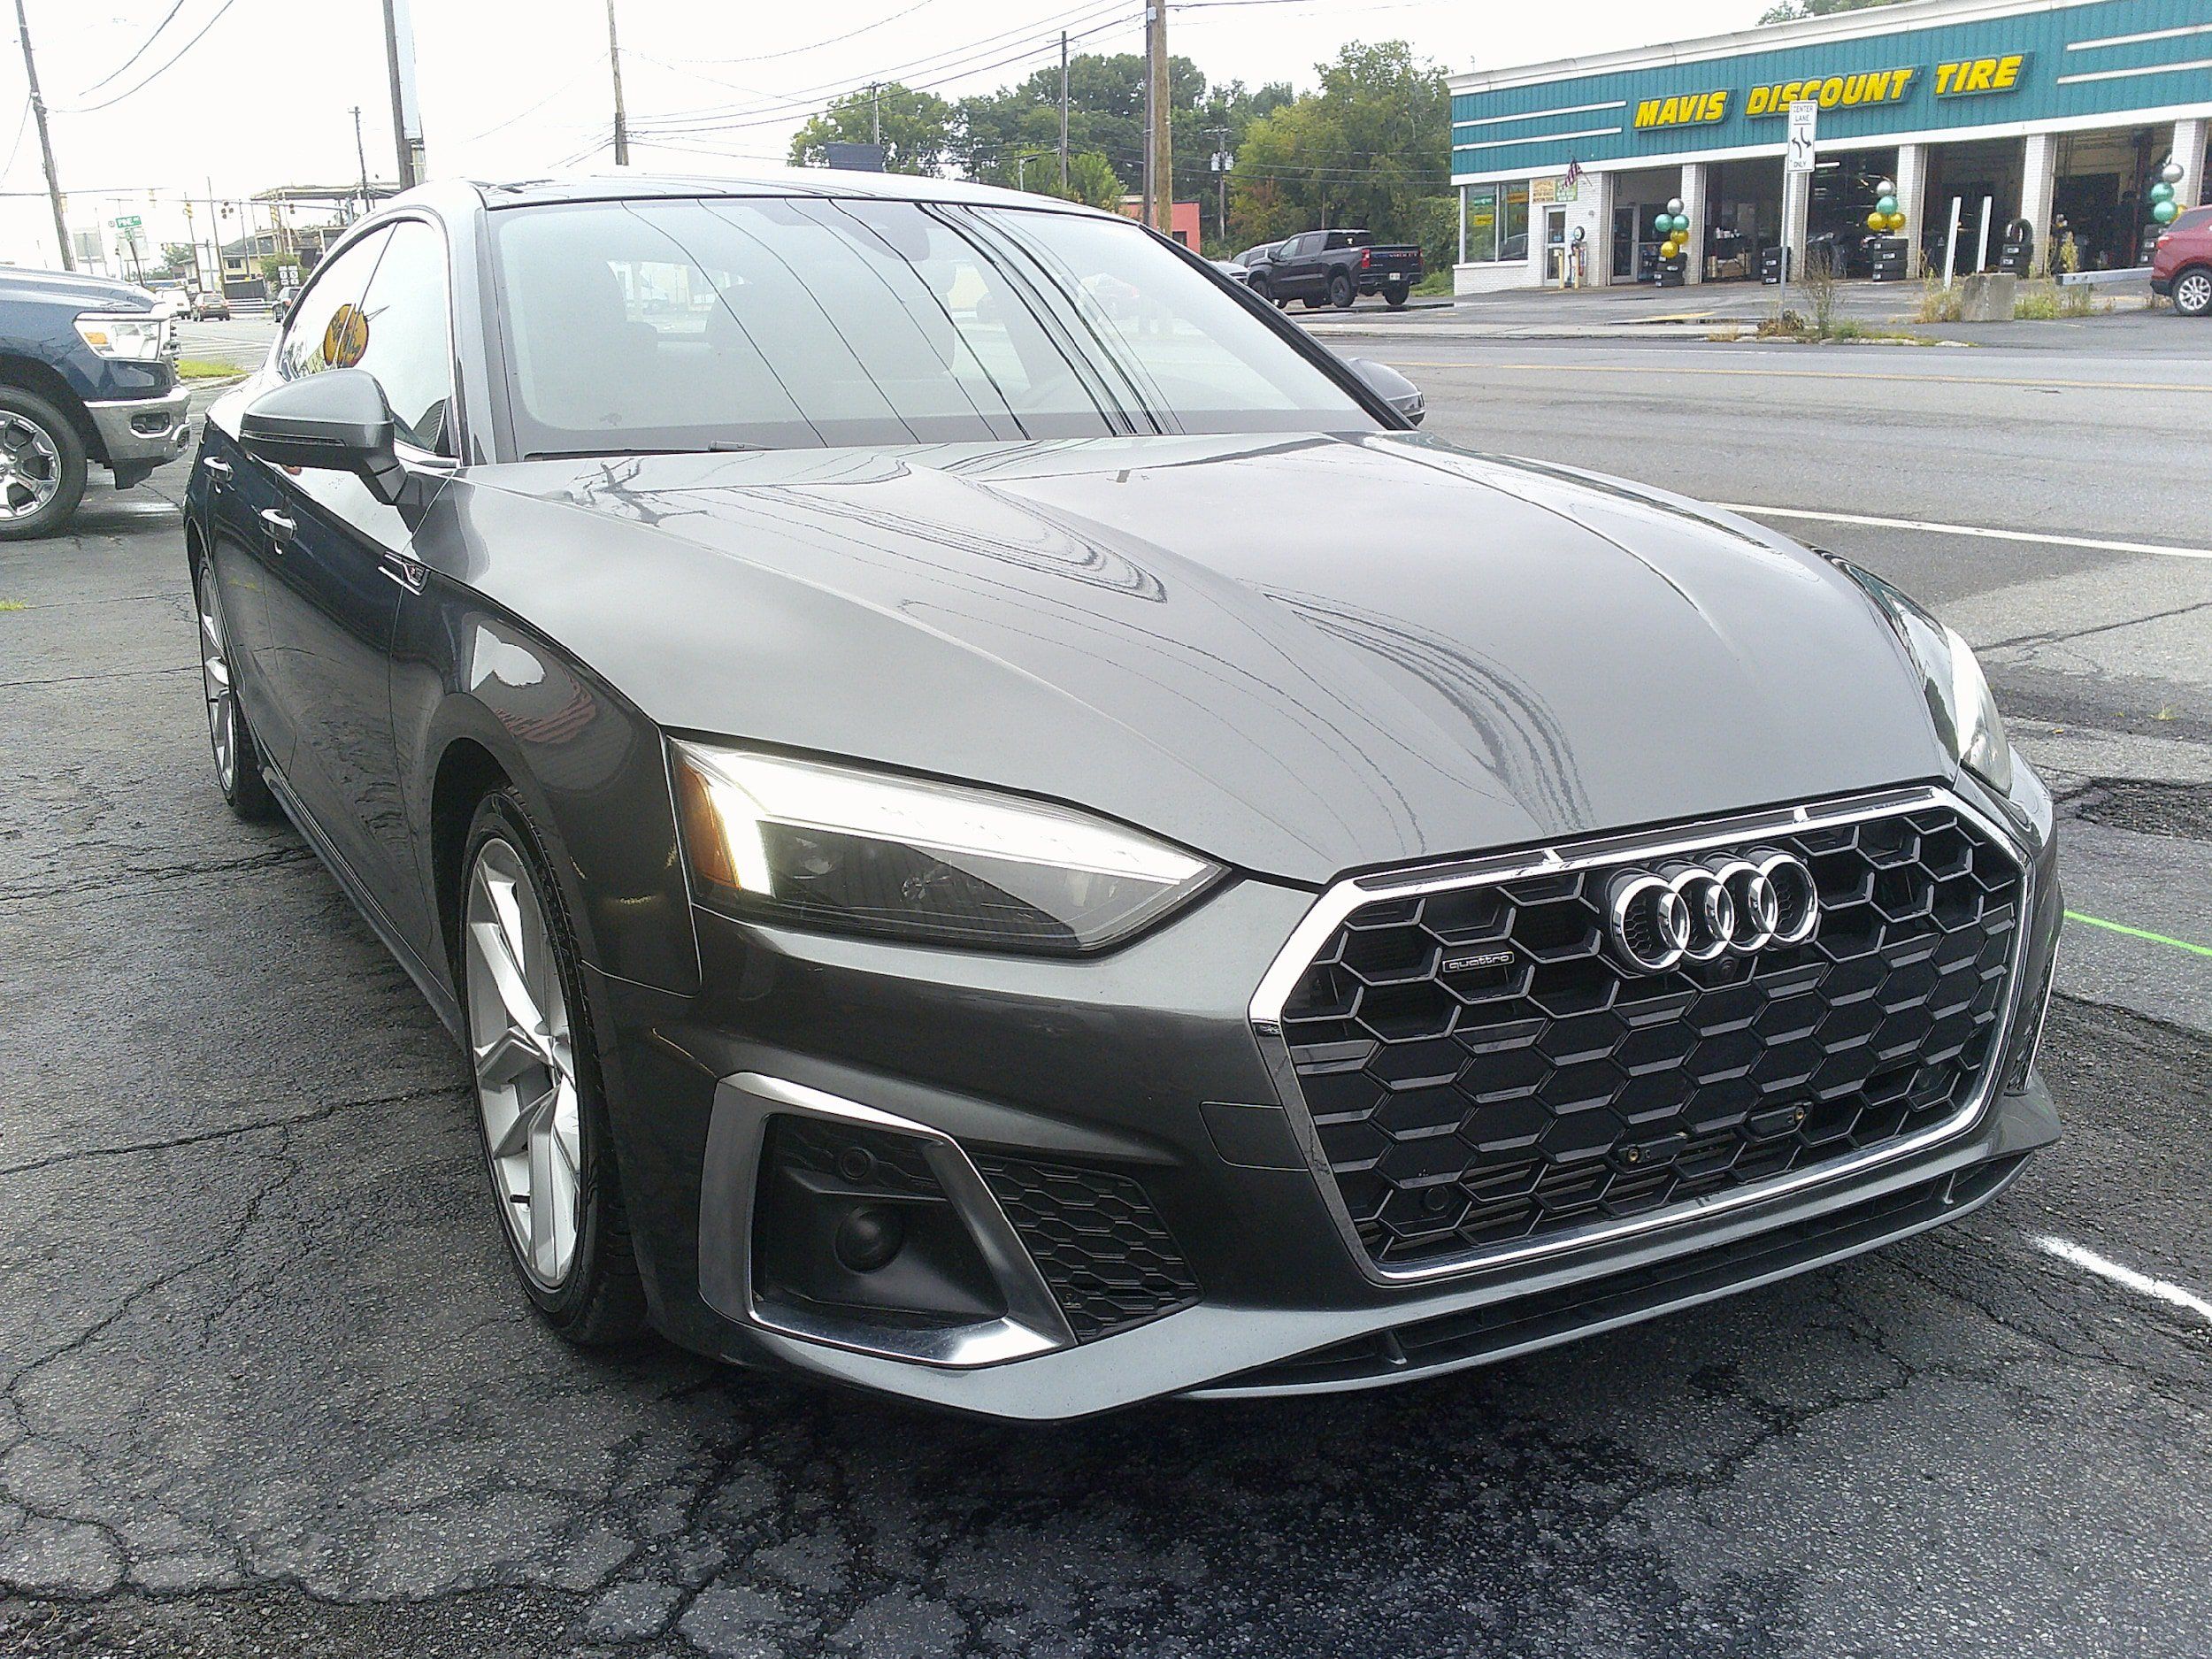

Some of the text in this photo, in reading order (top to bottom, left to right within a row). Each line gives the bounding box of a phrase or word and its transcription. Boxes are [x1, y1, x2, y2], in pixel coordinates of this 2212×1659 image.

[1633, 55, 2024, 128] MAVIS DISCOUNT TIRE
[1448, 955, 1509, 971] quattro
